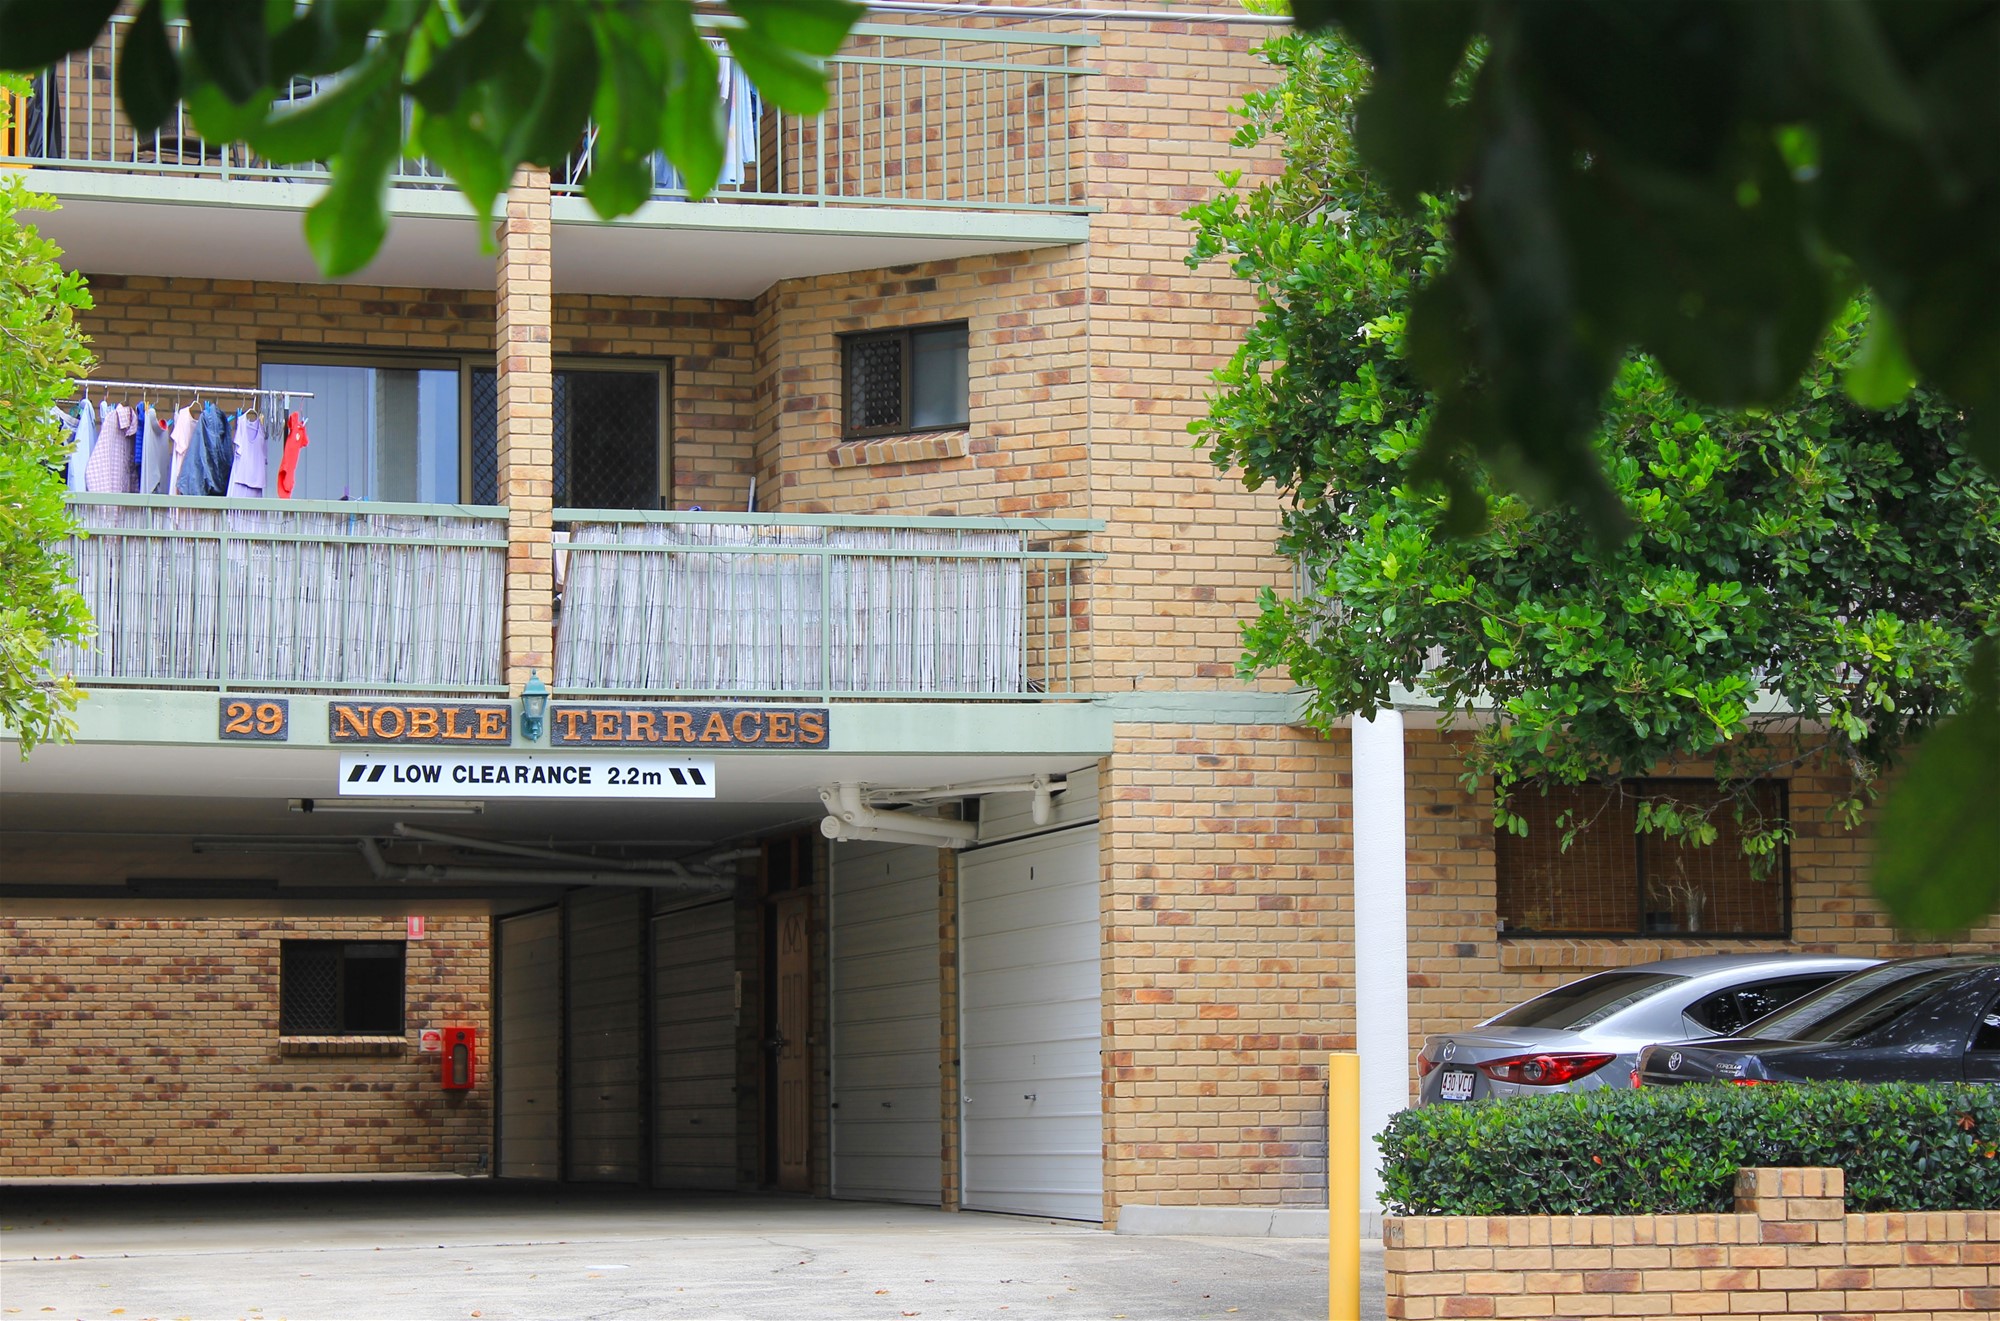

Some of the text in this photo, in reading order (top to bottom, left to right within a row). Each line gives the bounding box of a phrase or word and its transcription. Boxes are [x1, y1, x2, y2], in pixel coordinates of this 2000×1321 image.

[225, 702, 284, 735] 29
[334, 705, 827, 744] NOBLE TERRACES
[393, 764, 662, 785] LOW CLEARANCE 2.2m
